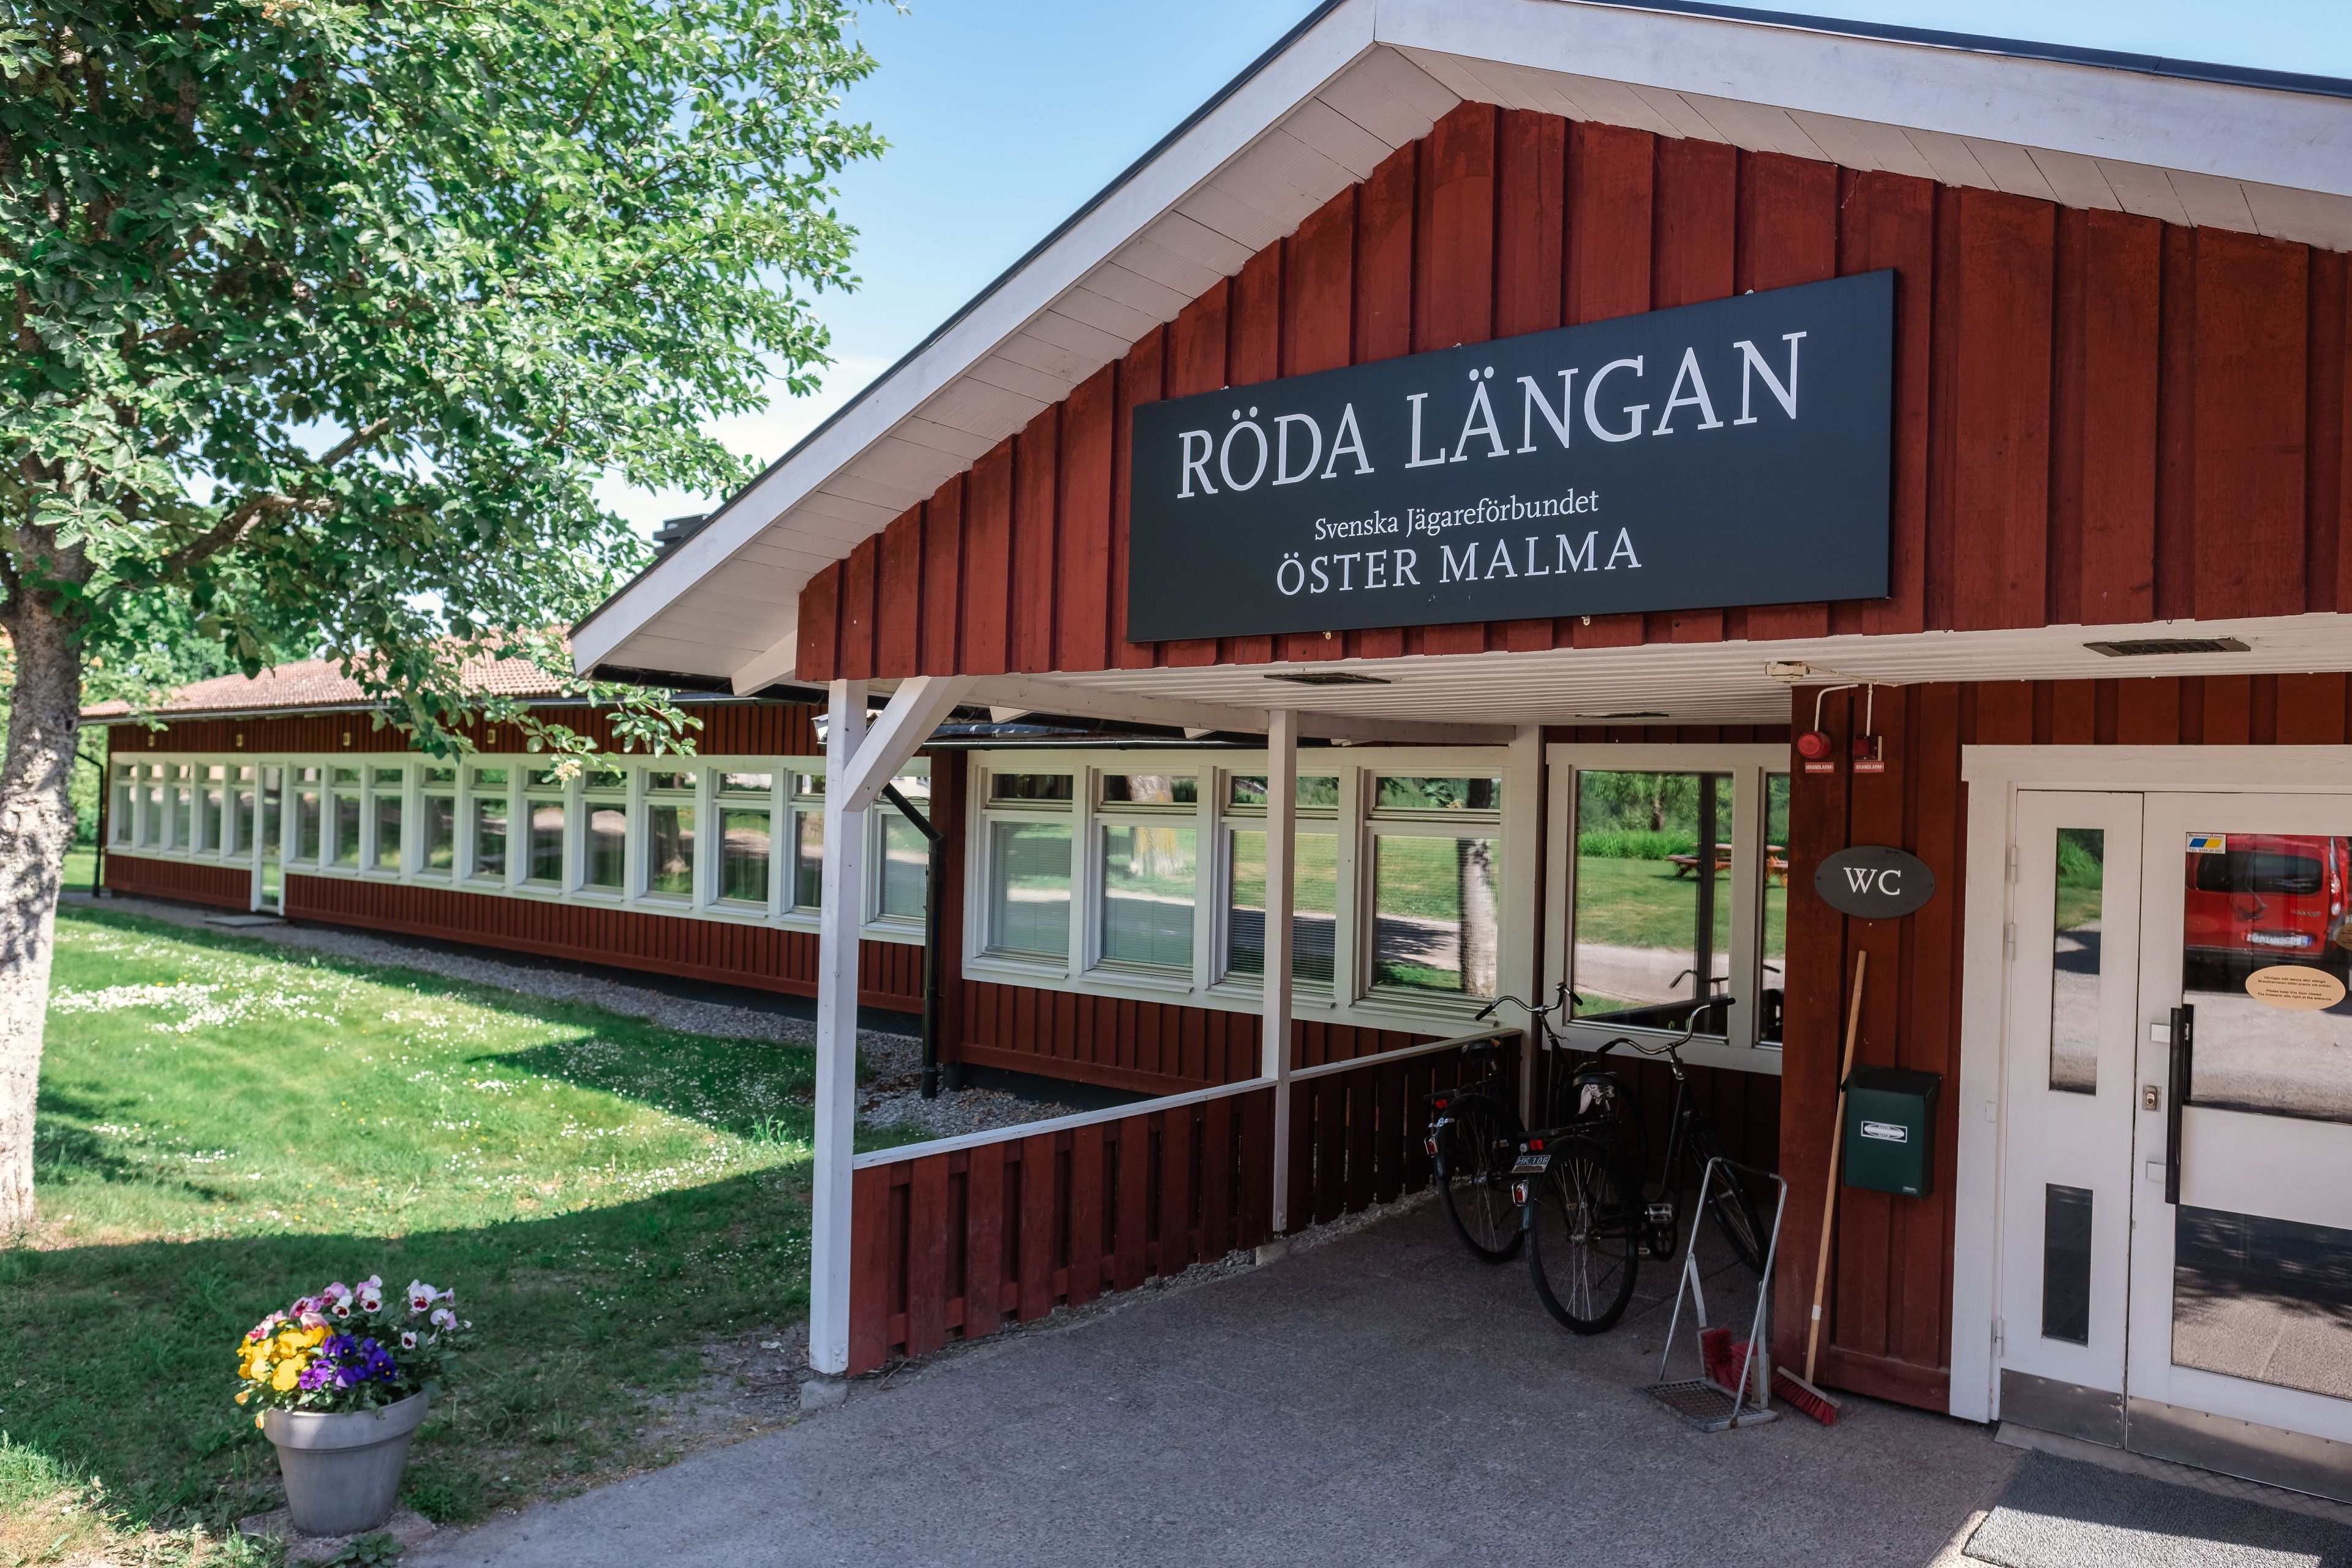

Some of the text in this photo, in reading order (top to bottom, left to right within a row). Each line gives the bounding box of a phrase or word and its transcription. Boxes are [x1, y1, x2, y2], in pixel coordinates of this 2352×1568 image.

[1177, 331, 1807, 499] RÖDA LÄNGAN
[1315, 488, 1599, 541] Svenska Jägareförbundet
[1277, 527, 1642, 595] ÖSTER MALMA
[1843, 867, 1901, 895] WC
